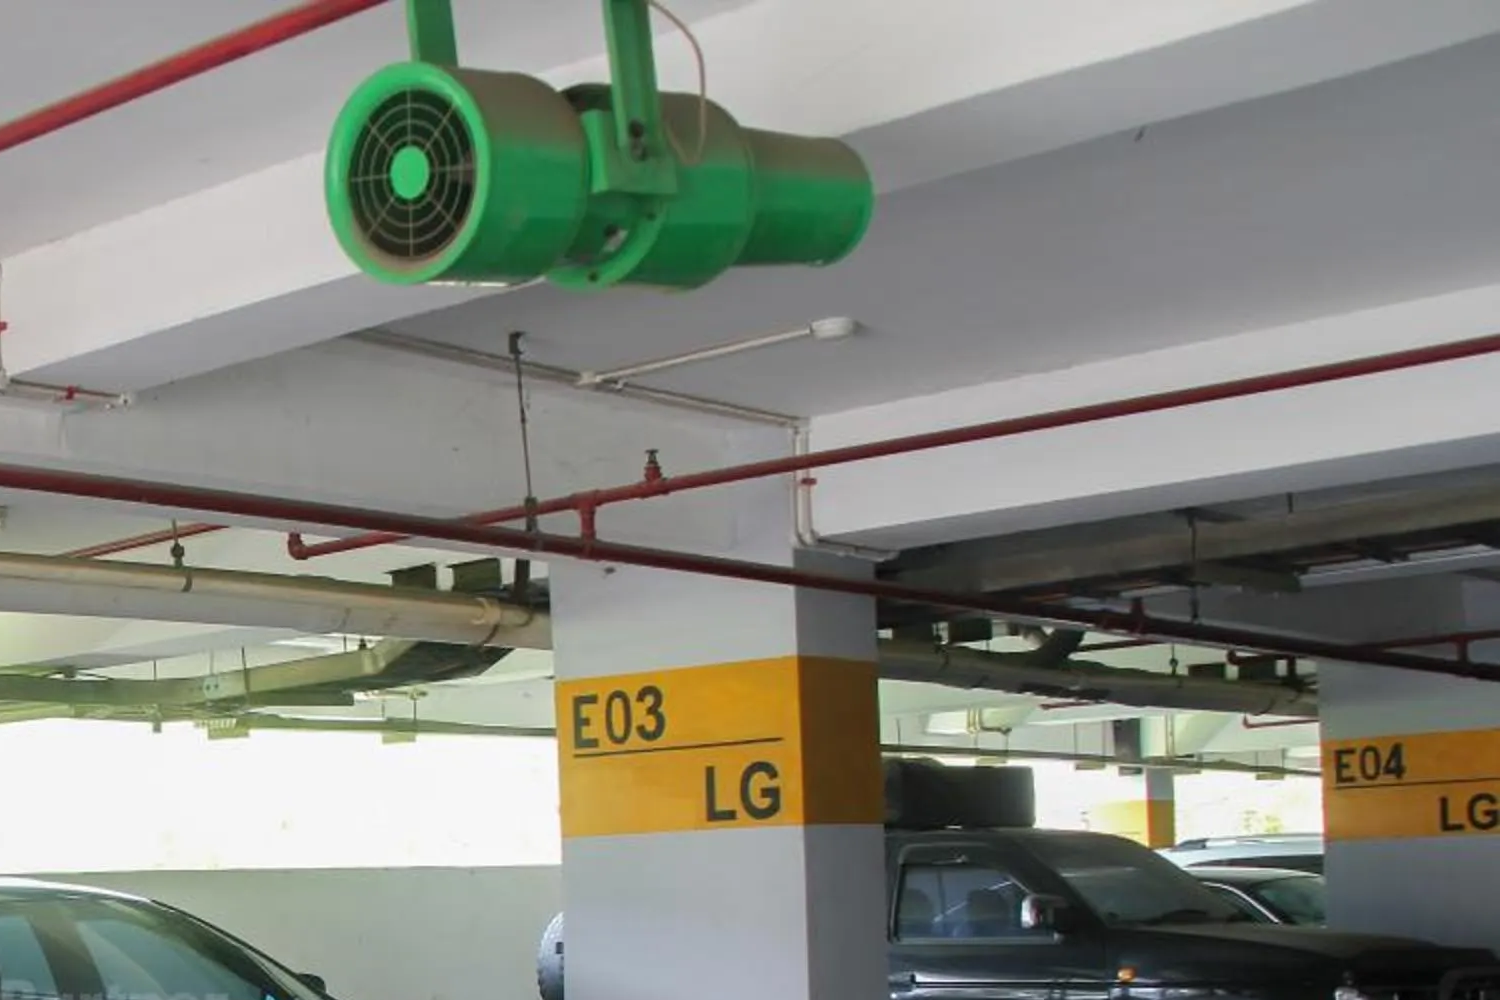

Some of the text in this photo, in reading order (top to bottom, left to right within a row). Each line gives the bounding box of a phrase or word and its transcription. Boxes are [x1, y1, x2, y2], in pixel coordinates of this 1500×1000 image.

[572, 685, 666, 749] E03
[1333, 741, 1407, 784] E04
[705, 760, 782, 822] LG
[1439, 792, 1500, 832] LG
